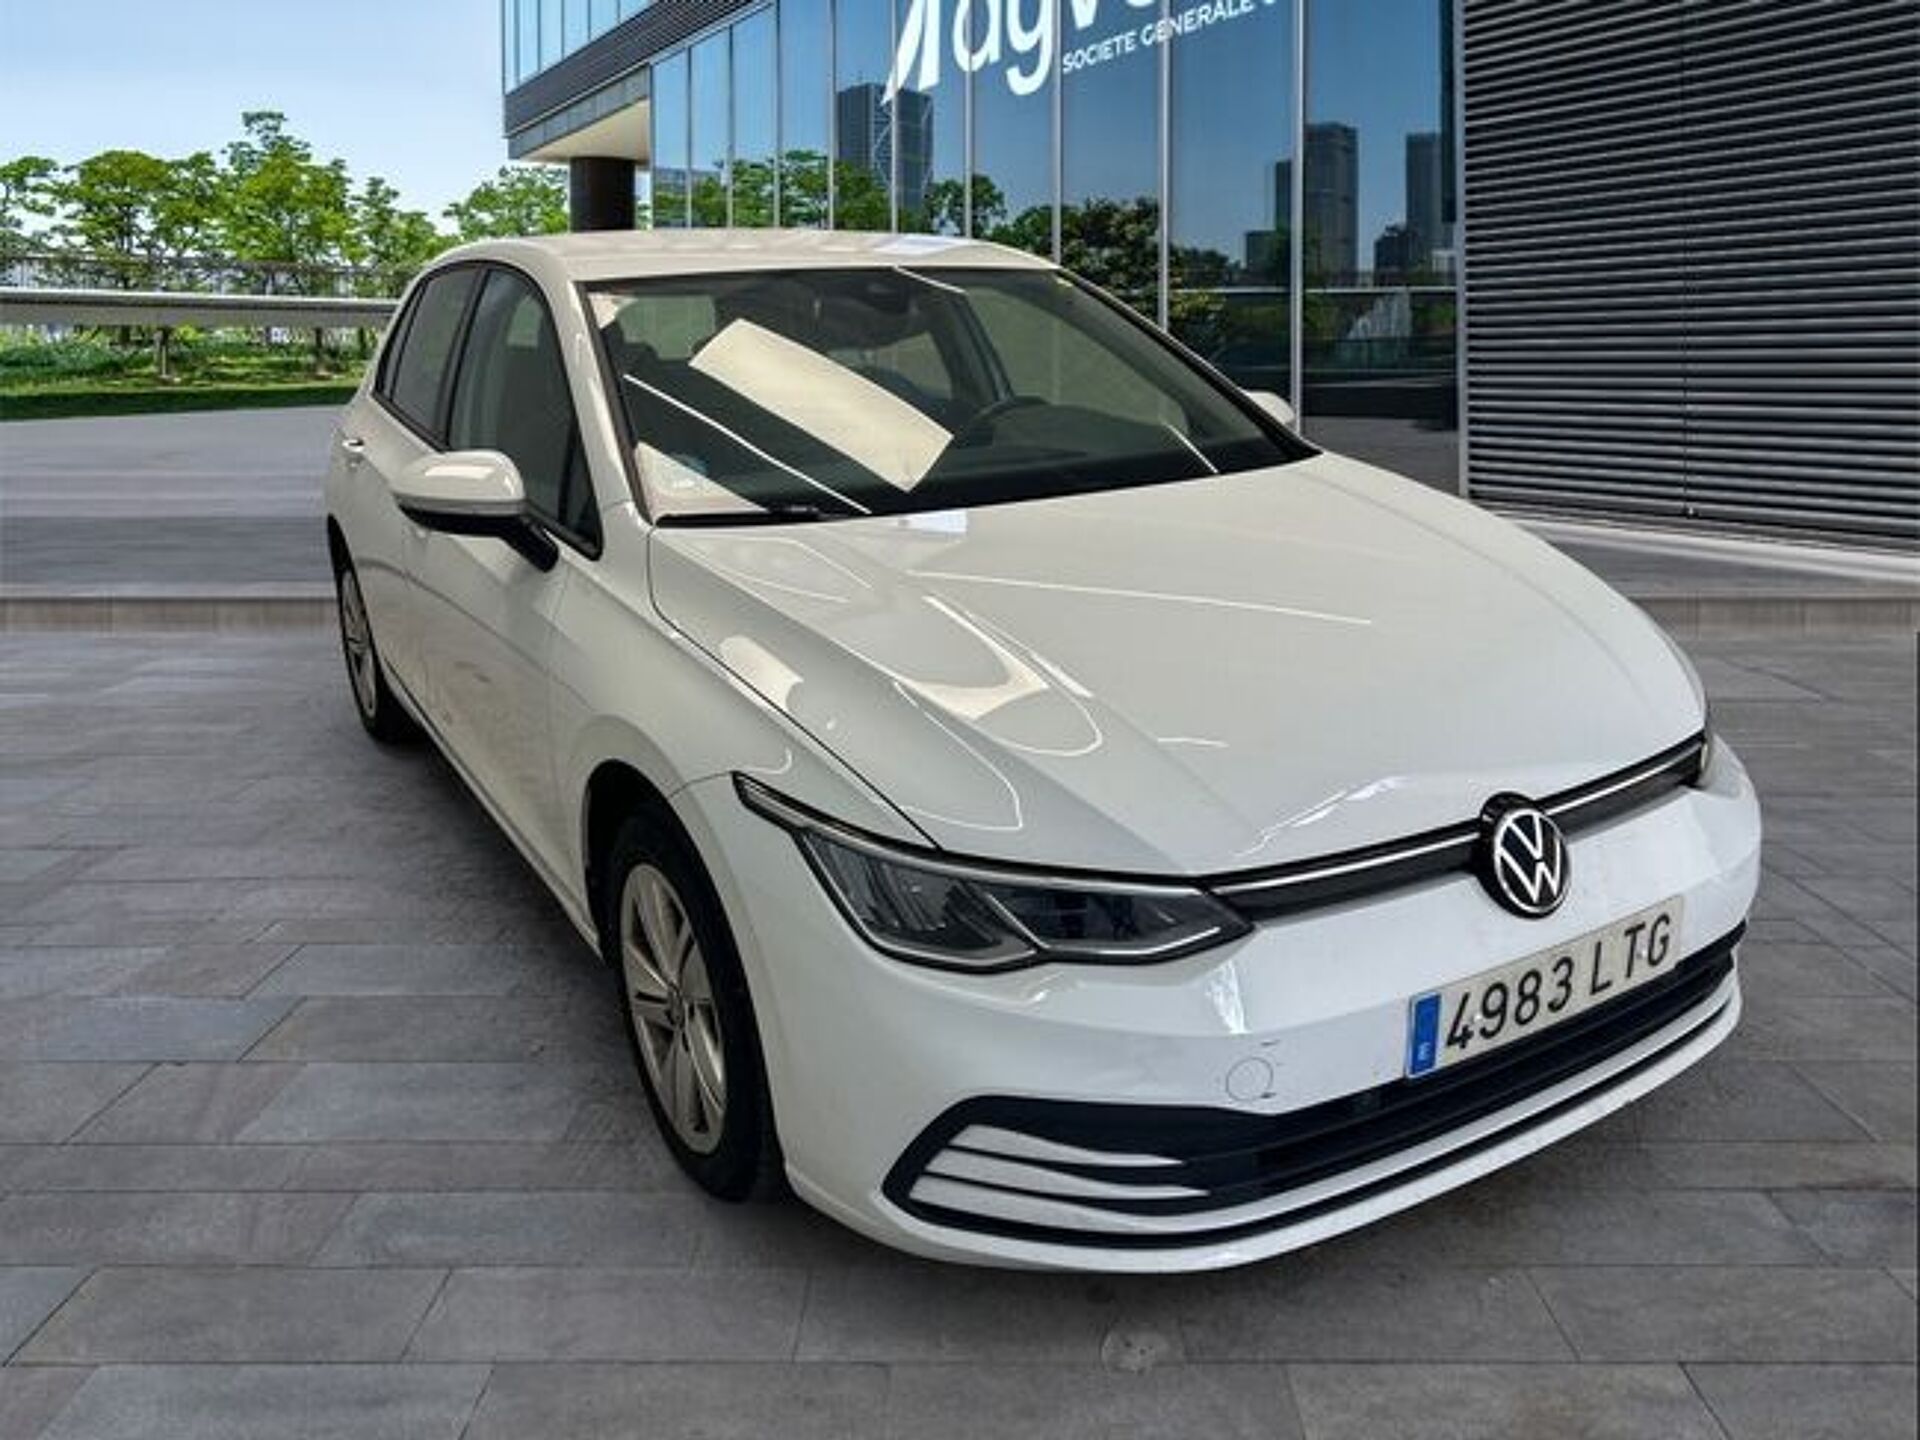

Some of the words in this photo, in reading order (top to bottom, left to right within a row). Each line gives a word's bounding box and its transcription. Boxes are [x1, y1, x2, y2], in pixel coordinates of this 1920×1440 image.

[1062, 31, 1137, 74] SOCIETE
[1446, 956, 1575, 1049] 4983
[1589, 912, 1671, 996] LTG
